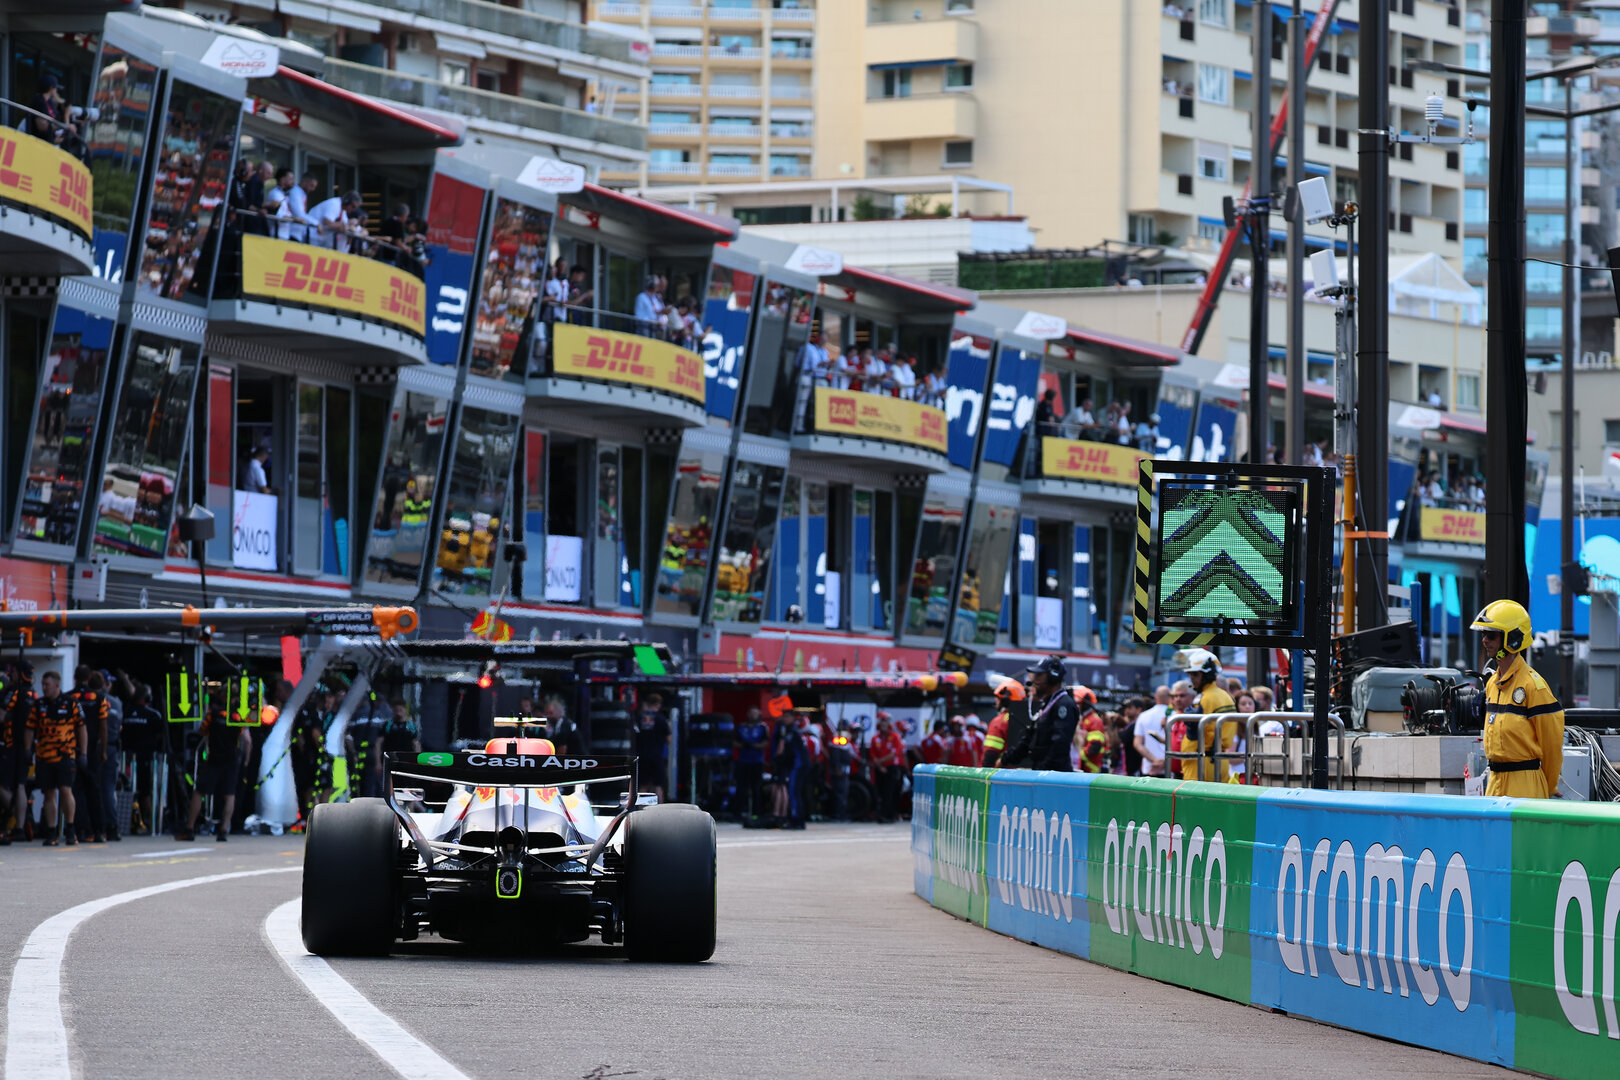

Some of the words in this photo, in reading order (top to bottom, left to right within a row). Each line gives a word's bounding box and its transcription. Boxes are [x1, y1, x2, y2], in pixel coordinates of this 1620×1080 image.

[58, 161, 91, 223] DHL
[281, 251, 353, 299] DHL
[389, 276, 422, 324] DHL
[586, 336, 645, 376] DHL
[675, 354, 701, 392] DHL
[920, 411, 945, 443] DHL
[1066, 446, 1112, 474] DHL
[233, 525, 271, 555] ONACO
[1442, 514, 1477, 537] DHL
[338, 613, 372, 621] WORLD
[467, 754, 535, 768] Cash
[542, 755, 599, 770] App
[998, 804, 1074, 924] aramco
[1103, 817, 1228, 960] aramco
[1277, 834, 1474, 1012] aramco
